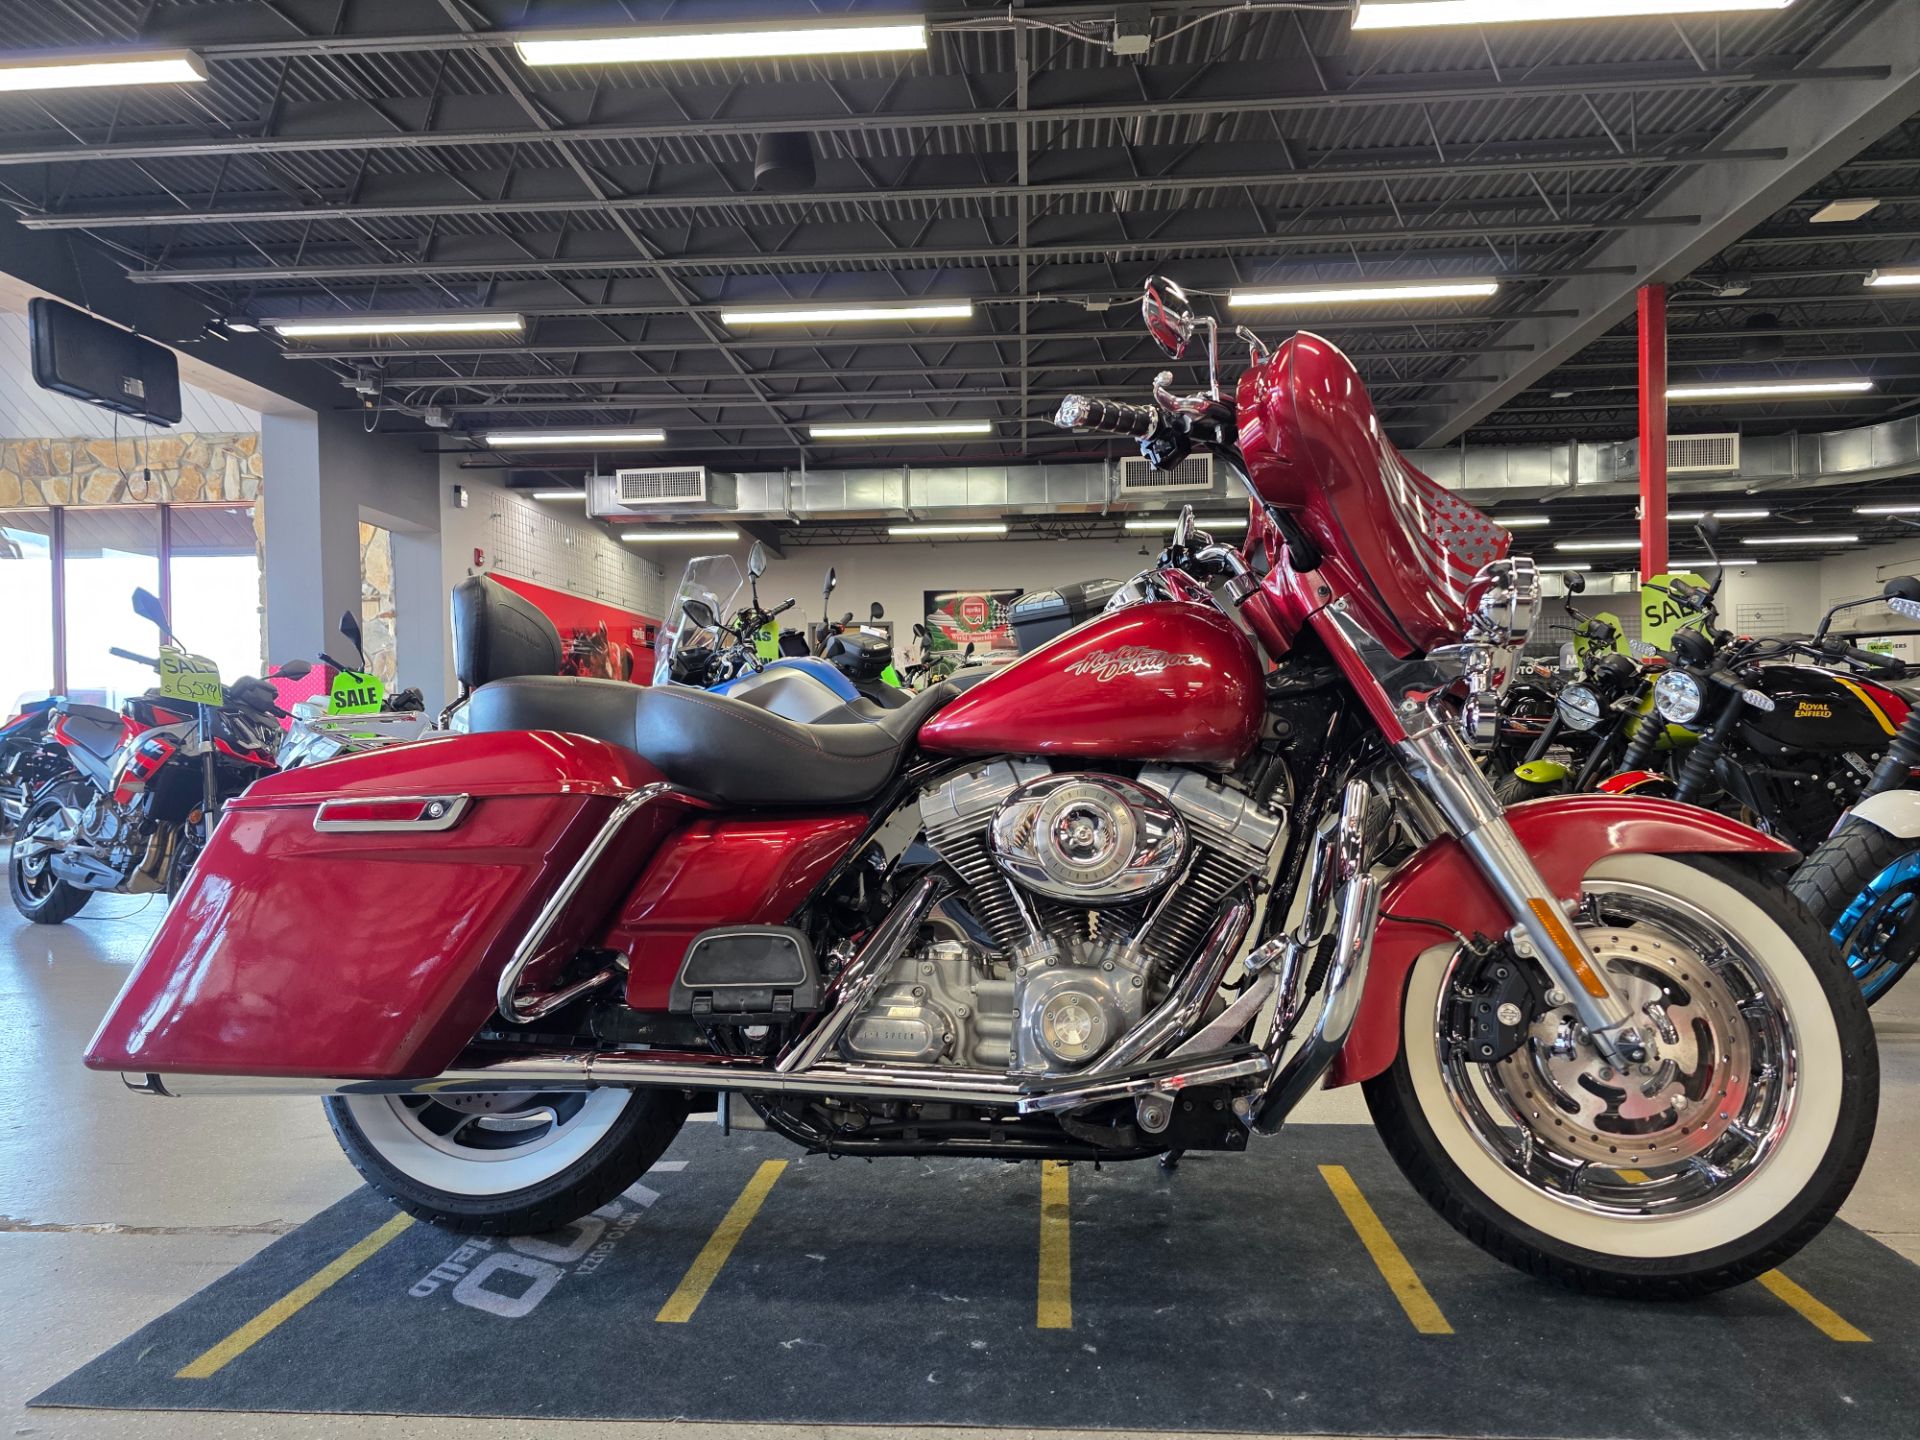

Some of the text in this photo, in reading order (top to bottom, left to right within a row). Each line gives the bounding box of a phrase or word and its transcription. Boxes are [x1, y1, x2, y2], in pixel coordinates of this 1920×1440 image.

[333, 686, 378, 708] SALE
[1799, 702, 1829, 711] ROYAL
[1794, 710, 1832, 718] ENFIELD
